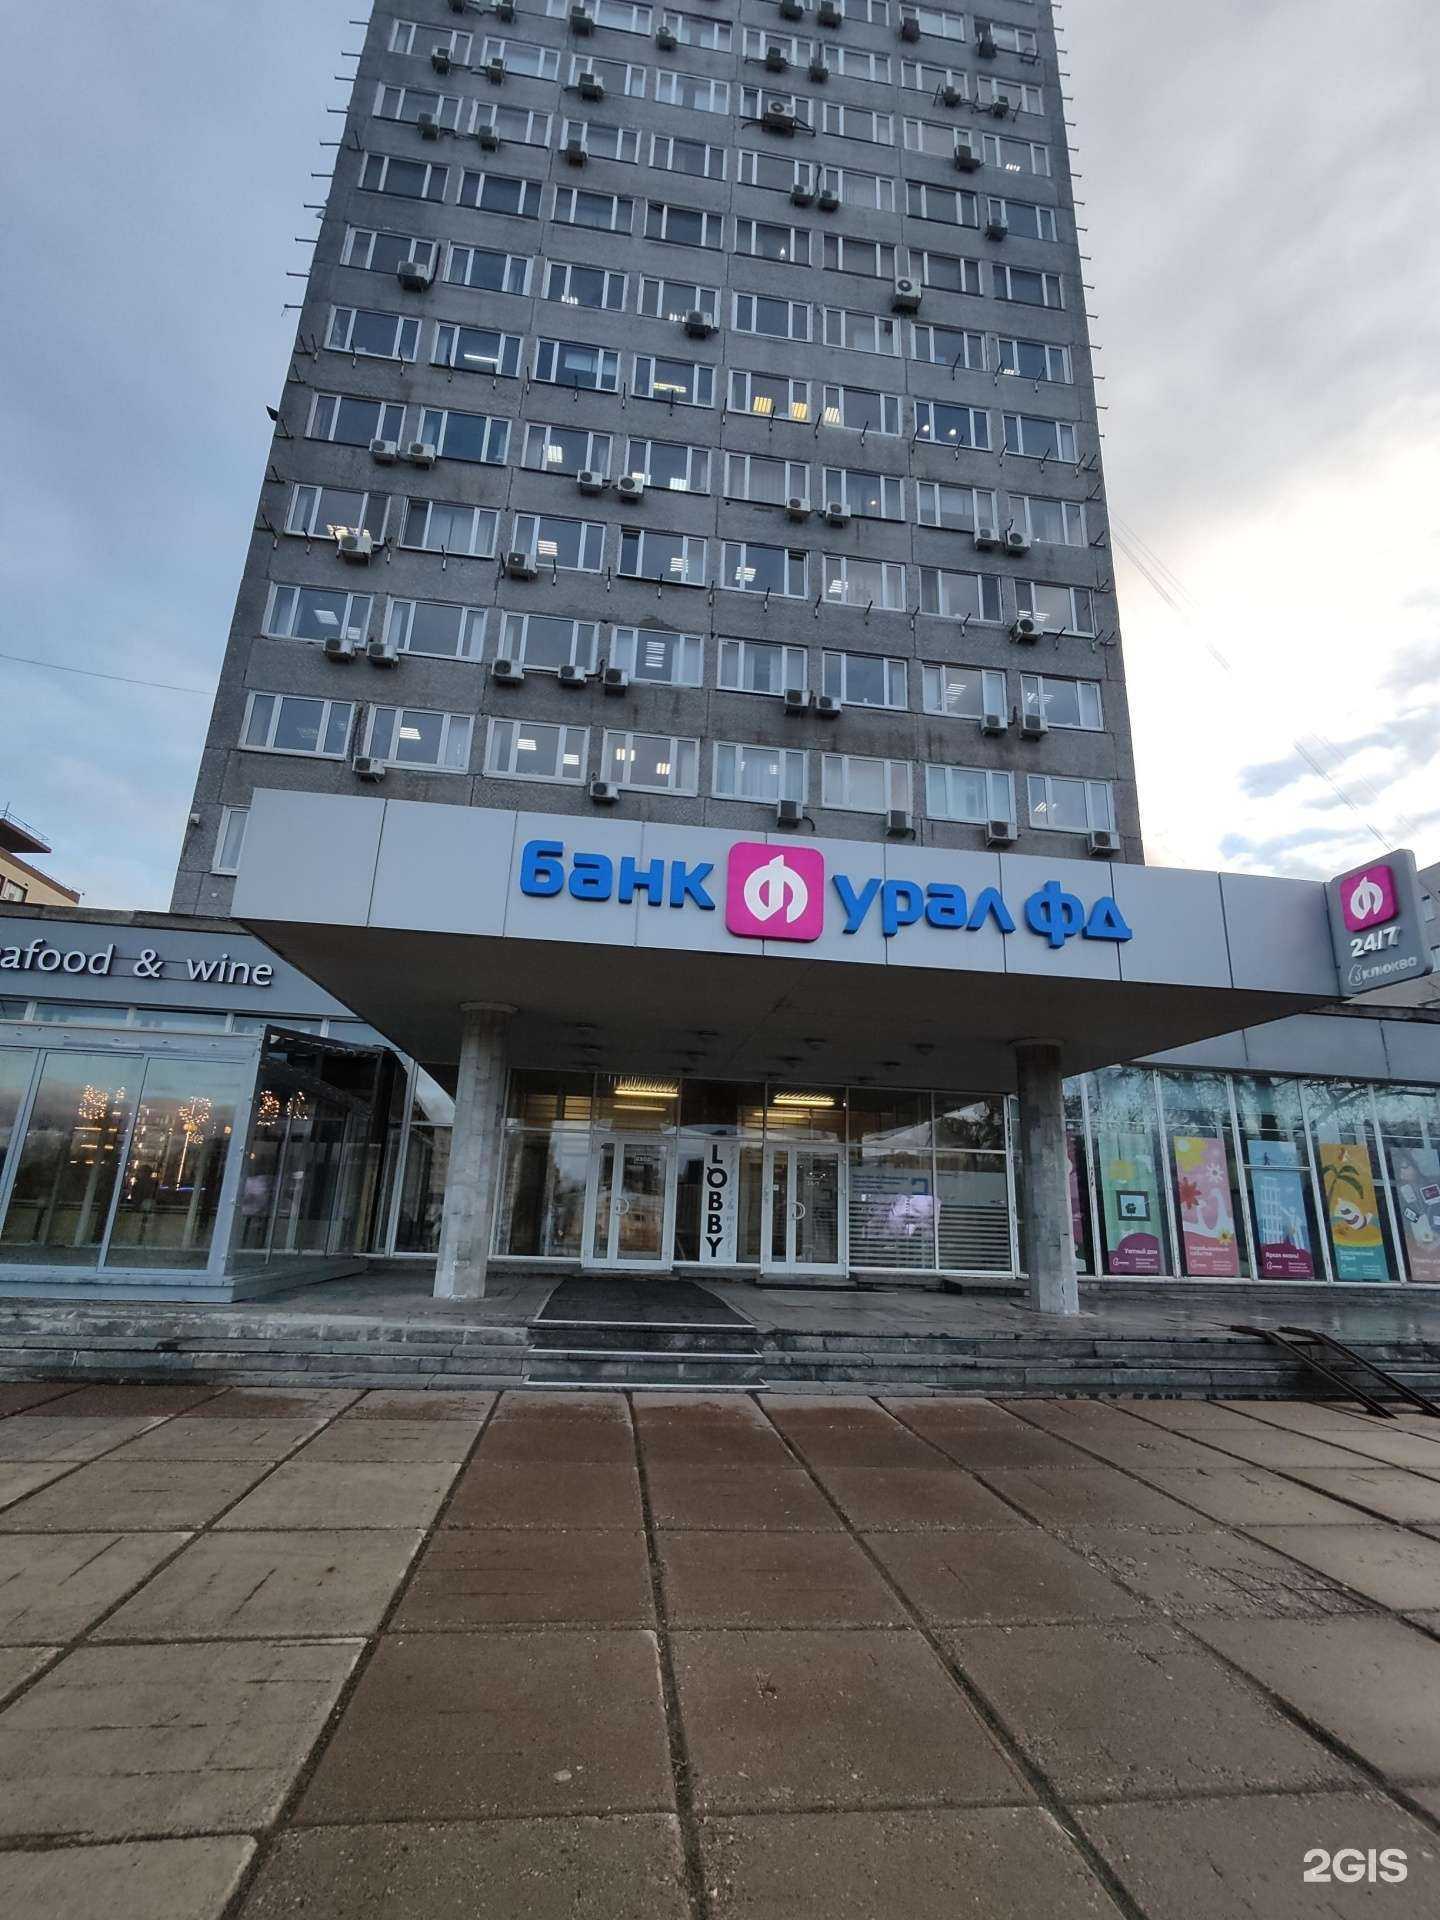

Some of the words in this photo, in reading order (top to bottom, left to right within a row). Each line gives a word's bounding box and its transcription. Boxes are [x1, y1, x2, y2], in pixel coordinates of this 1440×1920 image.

[520, 839, 715, 911] банк
[832, 874, 1016, 938] урал
[0, 938, 115, 976] afood
[133, 949, 164, 978] &
[186, 953, 273, 986] wine
[1350, 926, 1400, 958] 24/7
[705, 1144, 728, 1258] LOBBY
